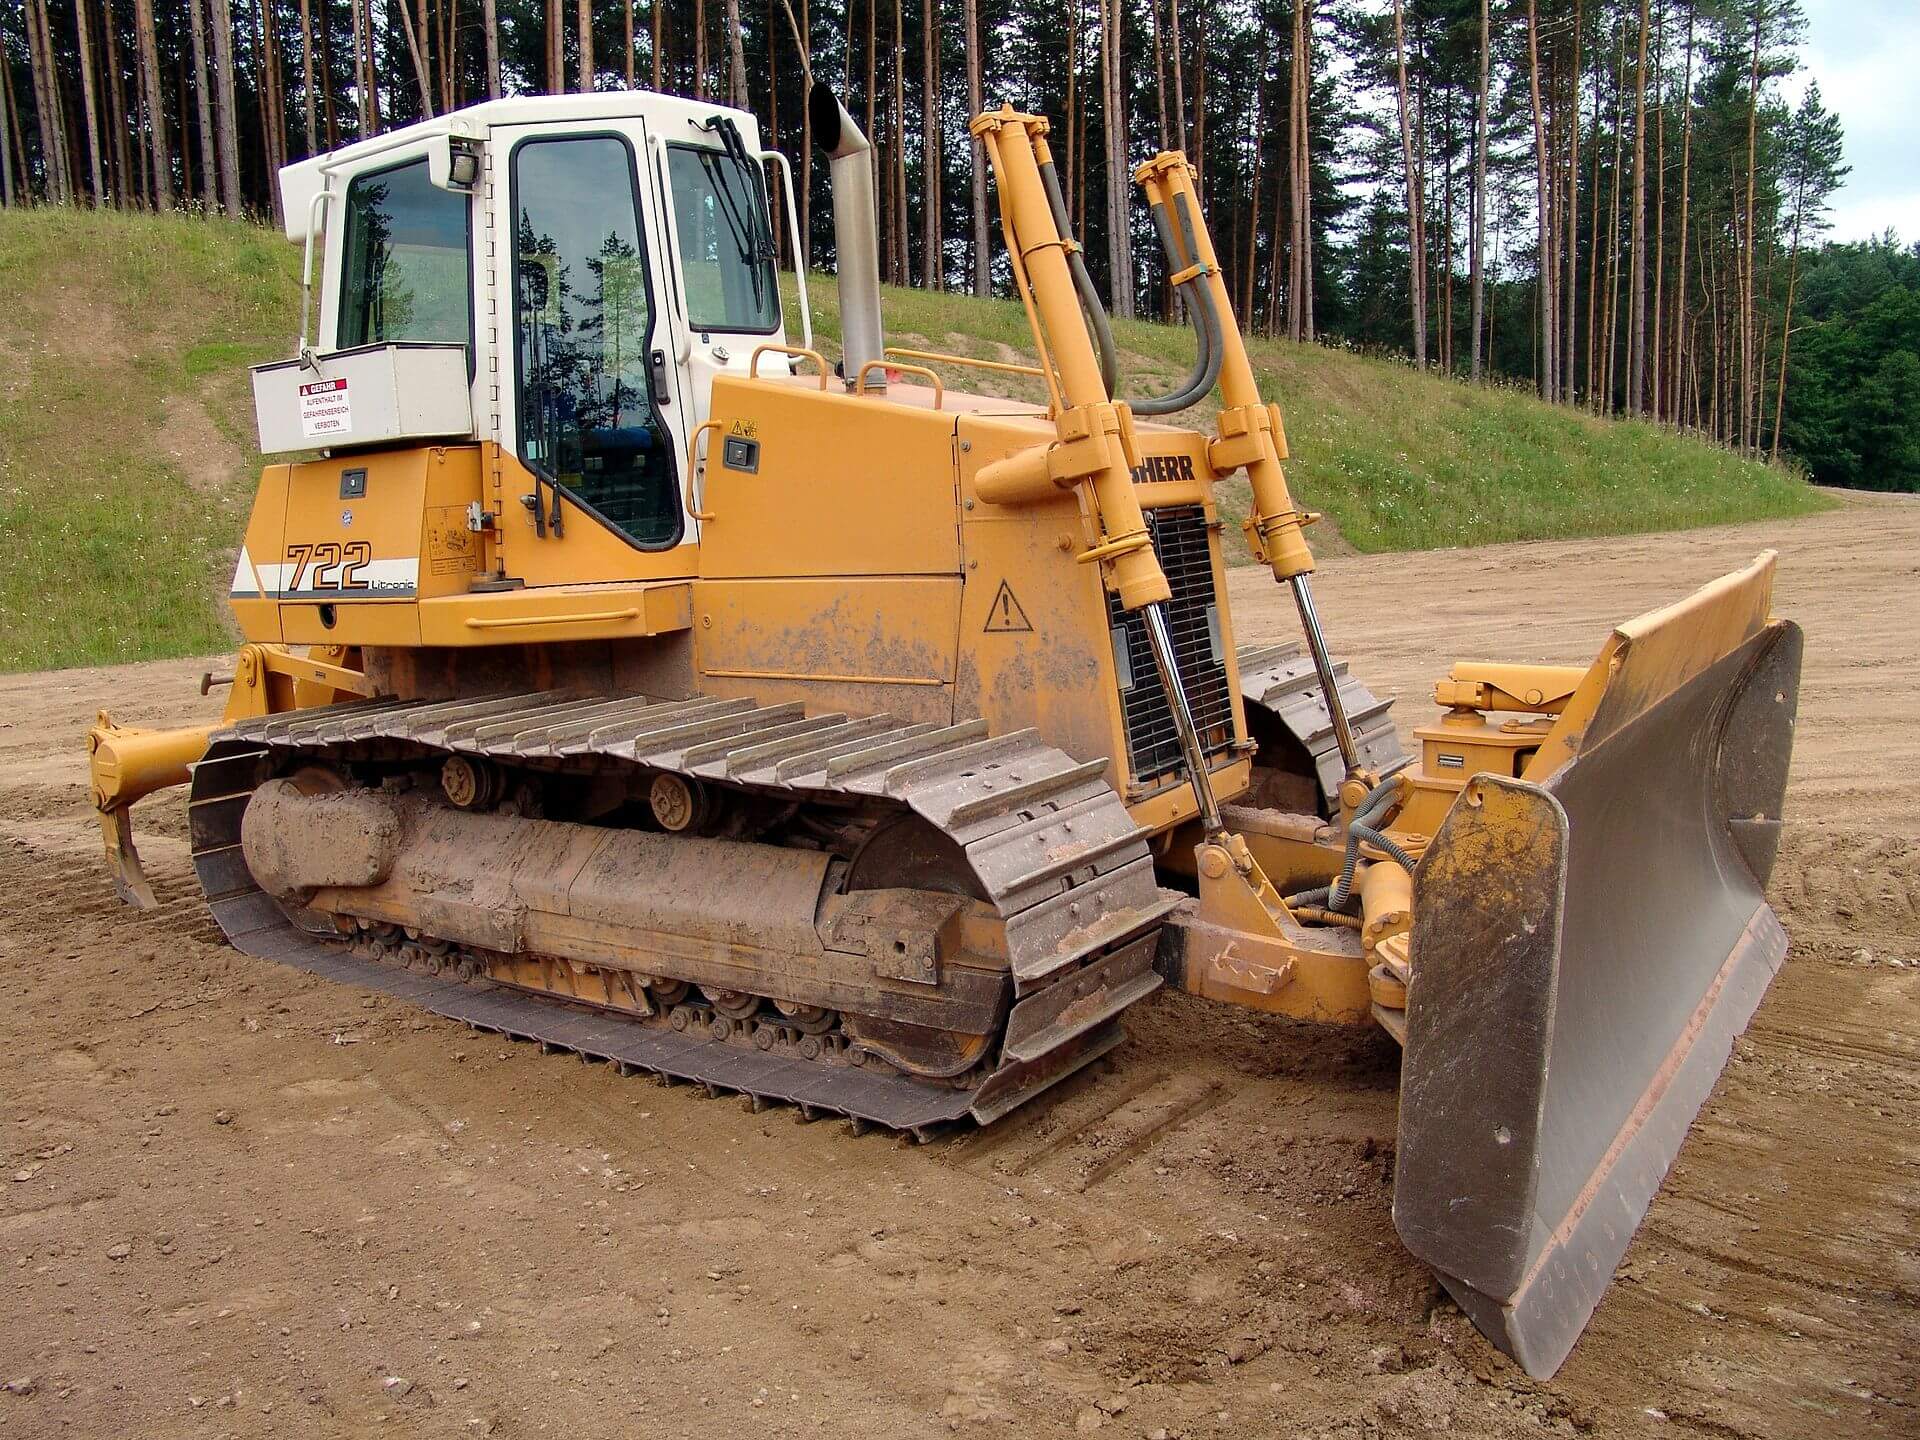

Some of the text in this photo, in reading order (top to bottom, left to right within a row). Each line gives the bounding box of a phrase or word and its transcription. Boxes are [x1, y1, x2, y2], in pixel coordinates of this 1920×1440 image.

[310, 381, 336, 393] GEFAHR
[306, 395, 336, 406] AUFENTHALT
[314, 420, 340, 430] VERBOTEN
[287, 541, 415, 591] 722 Litronic
